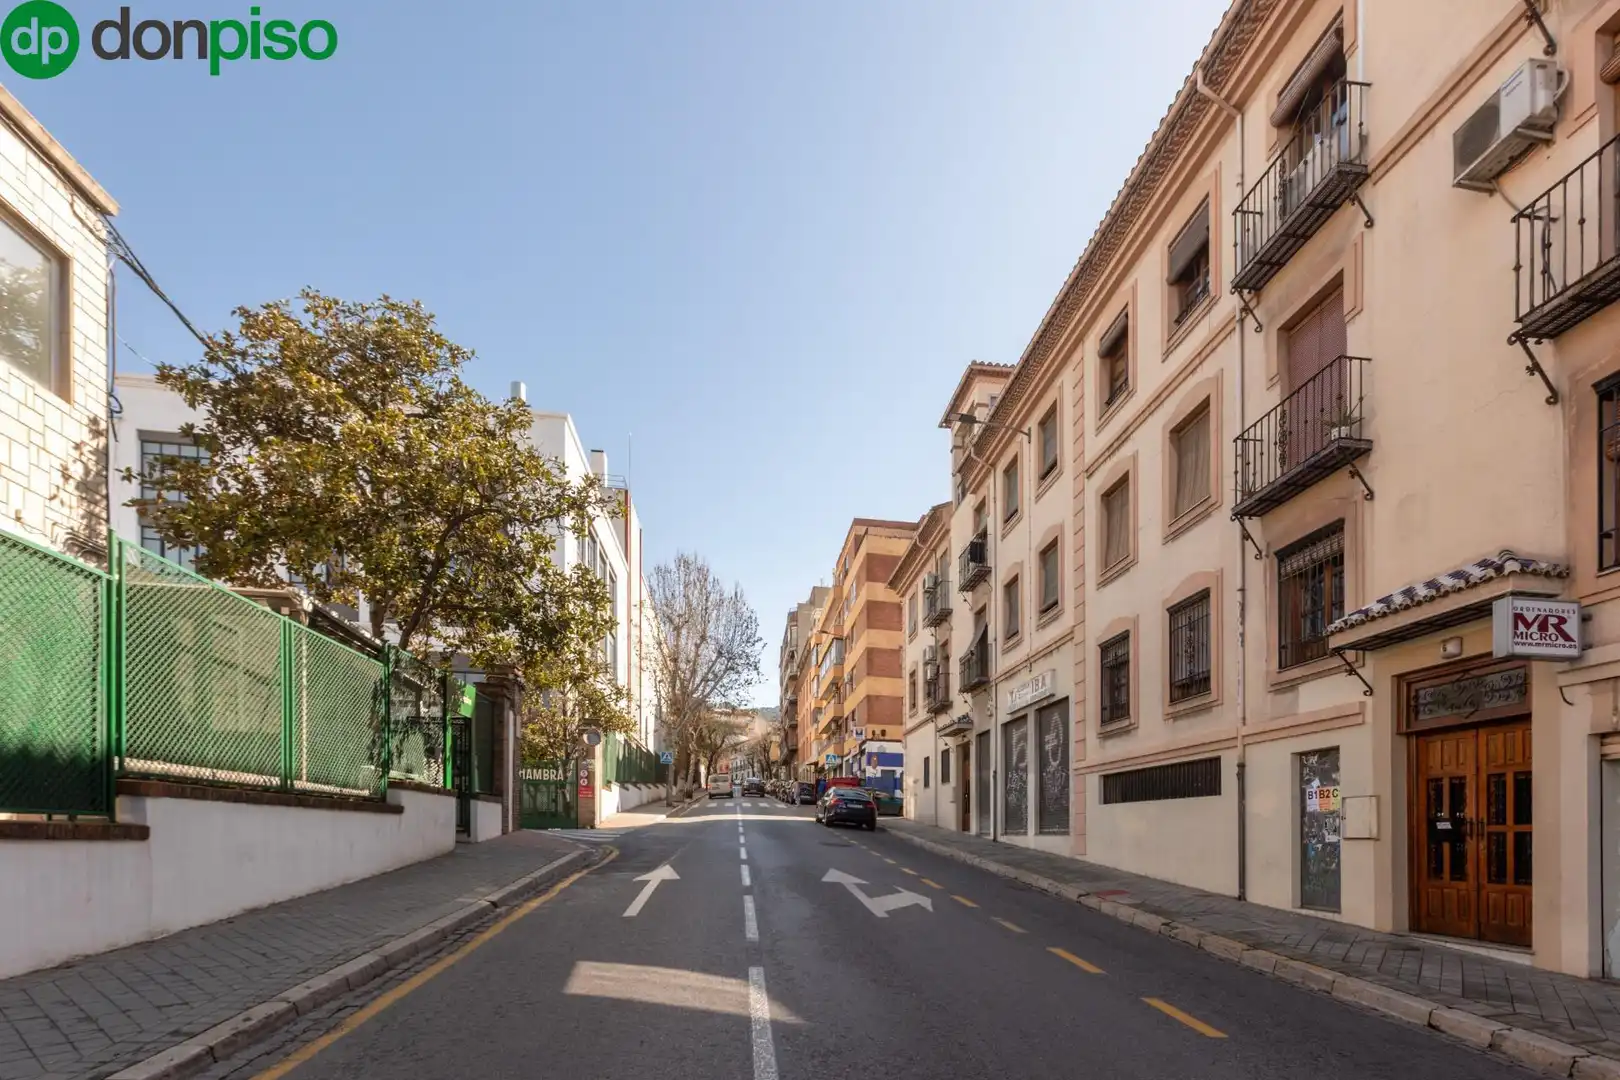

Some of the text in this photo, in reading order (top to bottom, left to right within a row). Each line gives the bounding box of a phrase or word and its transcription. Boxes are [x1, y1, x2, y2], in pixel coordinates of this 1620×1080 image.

[1513, 606, 1576, 614] ORDENADORES
[1513, 613, 1576, 643] MR
[1513, 631, 1559, 642] MICRO
[1514, 641, 1577, 649] www.mrmicro.es
[1308, 790, 1317, 800] B1
[1319, 789, 1330, 799] B2
